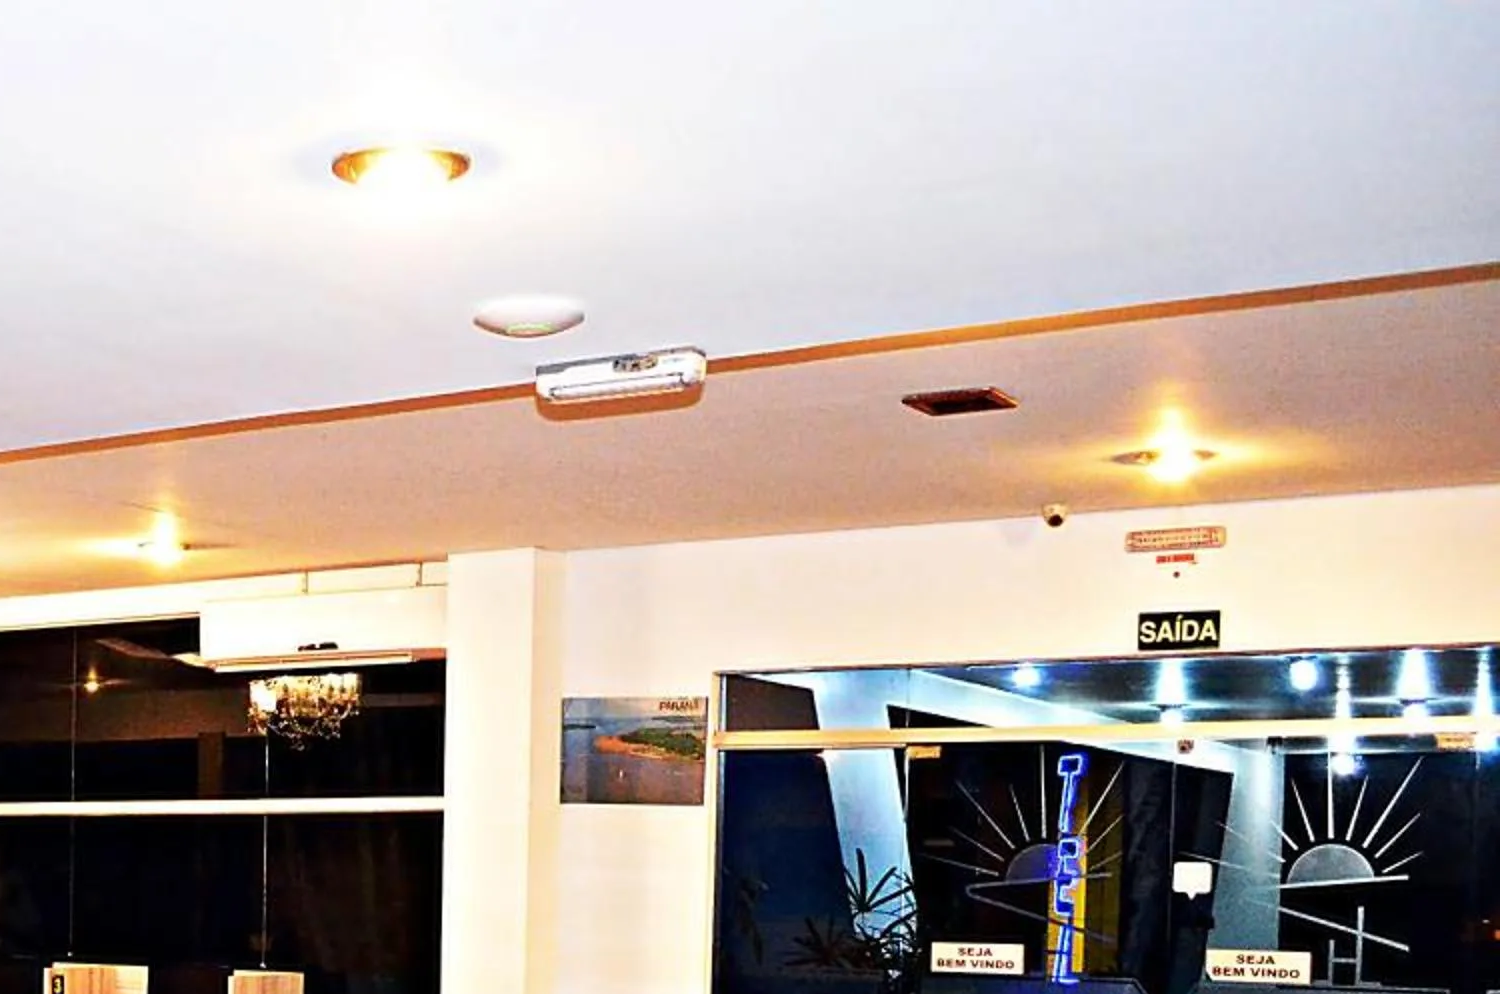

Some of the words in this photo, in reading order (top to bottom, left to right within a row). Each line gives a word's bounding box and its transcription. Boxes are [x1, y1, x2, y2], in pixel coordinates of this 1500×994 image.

[1139, 613, 1218, 643] SAÍDA
[957, 947, 993, 957] SEJA
[937, 958, 966, 968] BEM
[970, 959, 1015, 969] VINDO
[1236, 954, 1276, 965] SEJA
[1212, 966, 1245, 977] BEM
[1250, 967, 1301, 979] VINDO
[54, 977, 62, 994] 3
